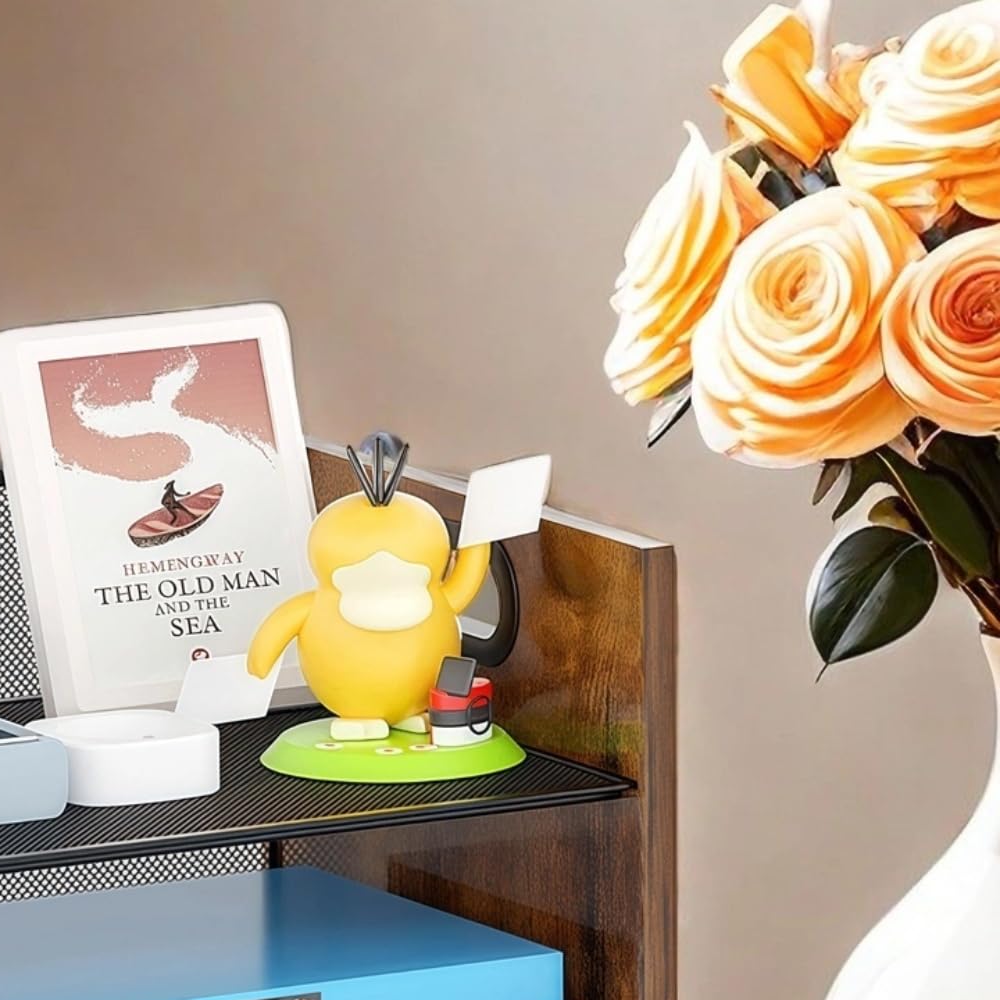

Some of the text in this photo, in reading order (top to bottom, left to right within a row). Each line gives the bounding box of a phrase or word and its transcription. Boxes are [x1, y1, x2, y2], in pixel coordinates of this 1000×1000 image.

[123, 551, 245, 576] HEMENGWAY
[94, 568, 281, 606] THE OLD MAN
[155, 596, 230, 616] AND THE
[170, 615, 222, 637] SEA
